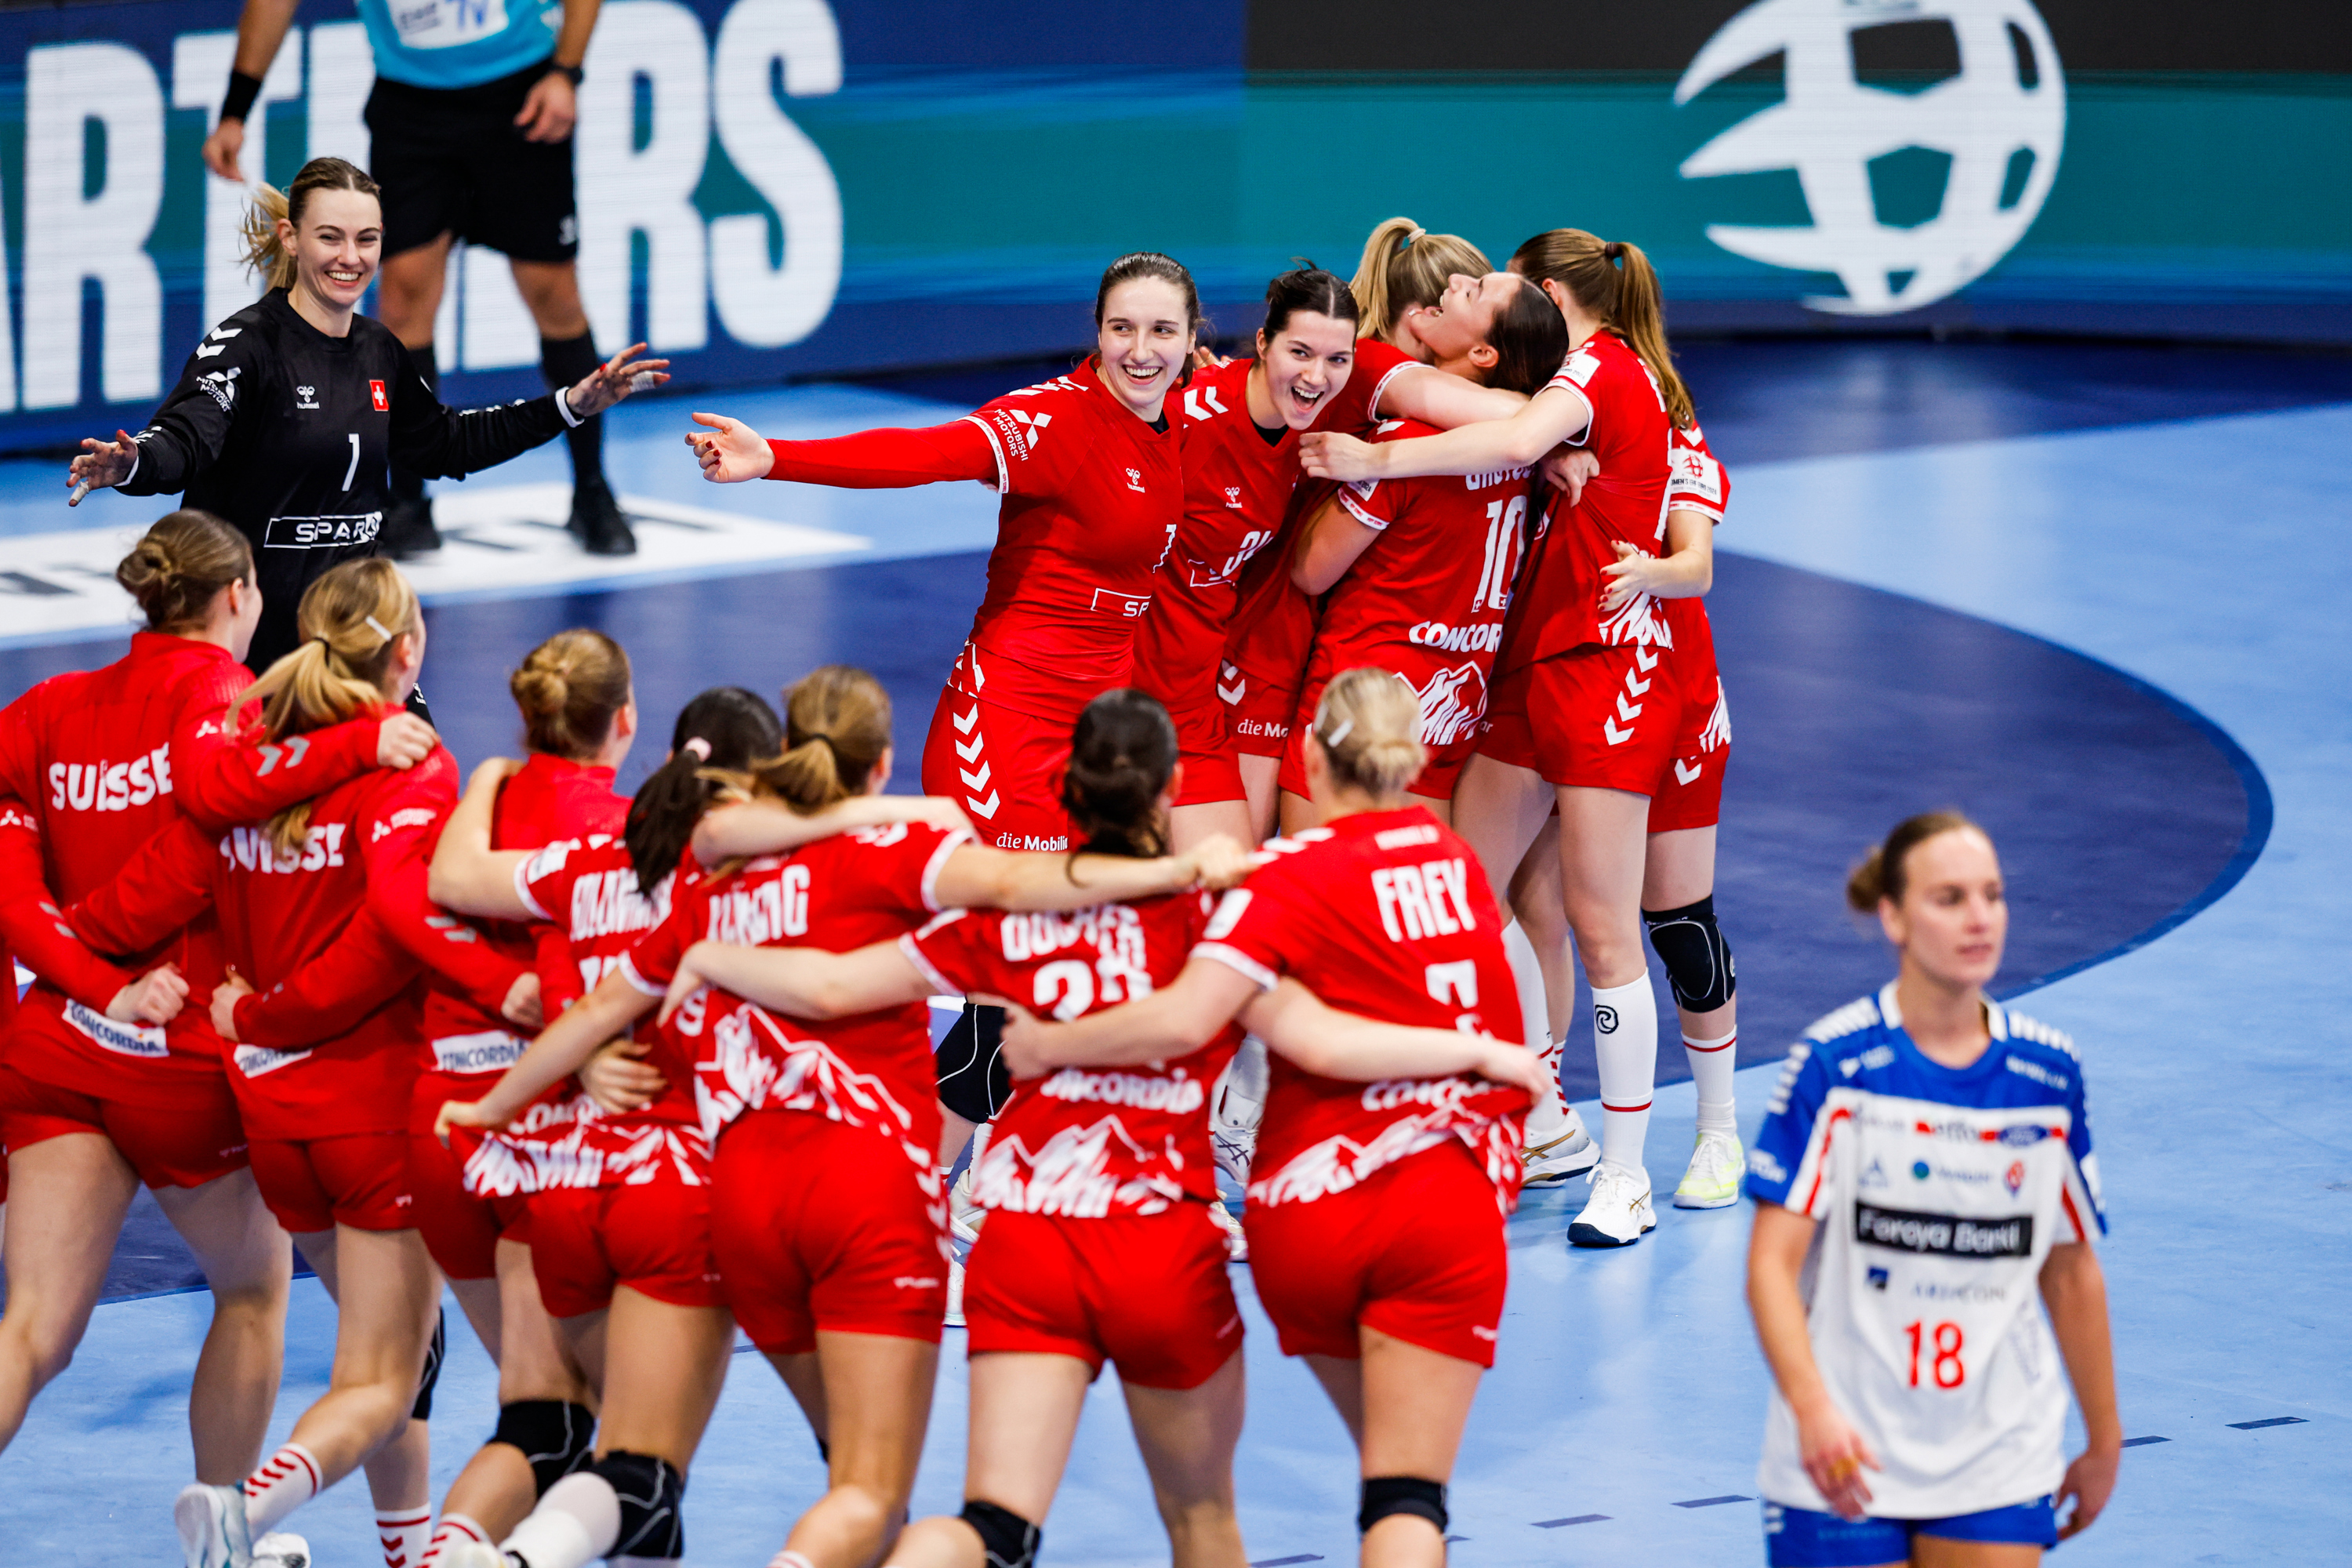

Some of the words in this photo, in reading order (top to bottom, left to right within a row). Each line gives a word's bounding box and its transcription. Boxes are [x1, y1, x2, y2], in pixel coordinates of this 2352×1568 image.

[343, 433, 360, 492] 7
[993, 416, 1018, 457] MOTORS
[994, 408, 1029, 462] MITSUBISHI
[1127, 482, 1145, 493] hummel
[1471, 495, 1528, 614] 10
[1237, 718, 1262, 735] die
[49, 741, 174, 812] SUISSE
[996, 832, 1022, 849] die
[1371, 858, 1476, 942] FREY
[1904, 1319, 1965, 1391] 18
